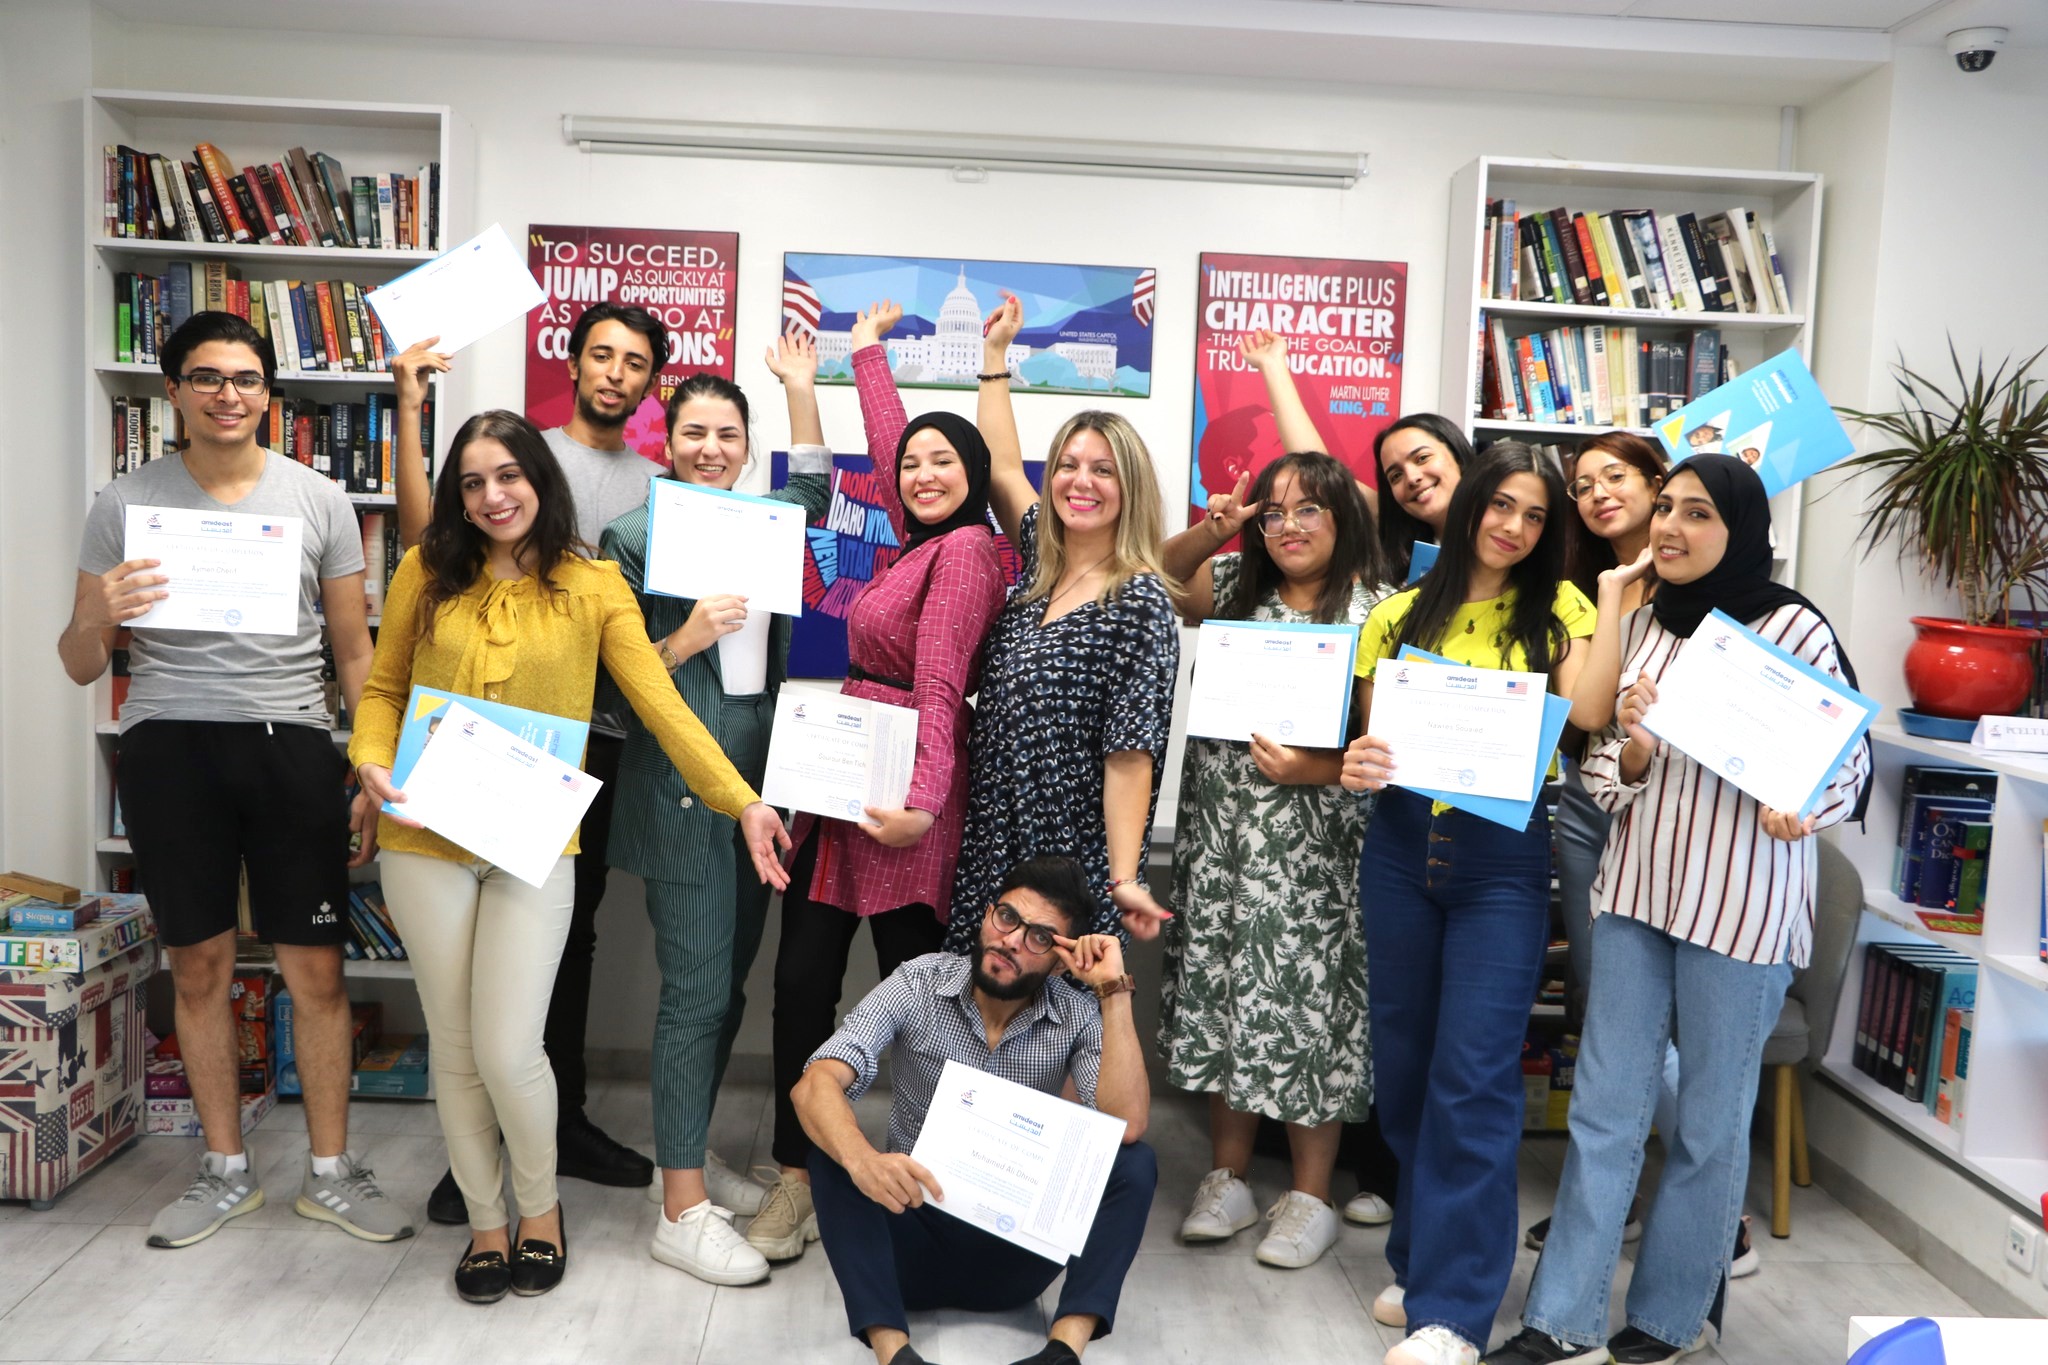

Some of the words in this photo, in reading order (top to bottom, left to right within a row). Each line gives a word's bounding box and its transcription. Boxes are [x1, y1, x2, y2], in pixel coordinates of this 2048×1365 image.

[589, 242, 726, 270] SUCCEED,
[1666, 227, 1686, 273] KENNETH
[210, 279, 222, 303] BROWN
[543, 266, 618, 302] JUMP
[622, 270, 643, 285] AS
[645, 271, 706, 287] QUICKLY
[707, 273, 726, 288] AT
[620, 285, 726, 306] OPPORTUNITIES
[1345, 277, 1396, 307] PLUS
[538, 303, 572, 324] AS
[694, 309, 725, 330] AT
[1205, 301, 1395, 338] CHARACTER
[1315, 337, 1364, 354] GOAL
[1369, 341, 1393, 355] OF
[1206, 349, 1259, 373] TRUE
[1527, 356, 1538, 387] COOL
[1330, 385, 1361, 400] MARTIN
[1362, 387, 1390, 401] LUTHER
[1329, 400, 1367, 418] KING,
[1370, 402, 1390, 416] JR.
[129, 413, 139, 447] KOONTZ
[826, 468, 866, 537] IDAHO
[201, 519, 233, 527] amideast
[839, 538, 875, 582] UTAH
[1446, 674, 1478, 683] amideast
[1764, 663, 1795, 686] amideast
[837, 712, 863, 723] amideast
[116, 917, 149, 949] LIFE
[1012, 1111, 1045, 1131] amideast
[971, 1149, 1006, 1172] Mohamed
